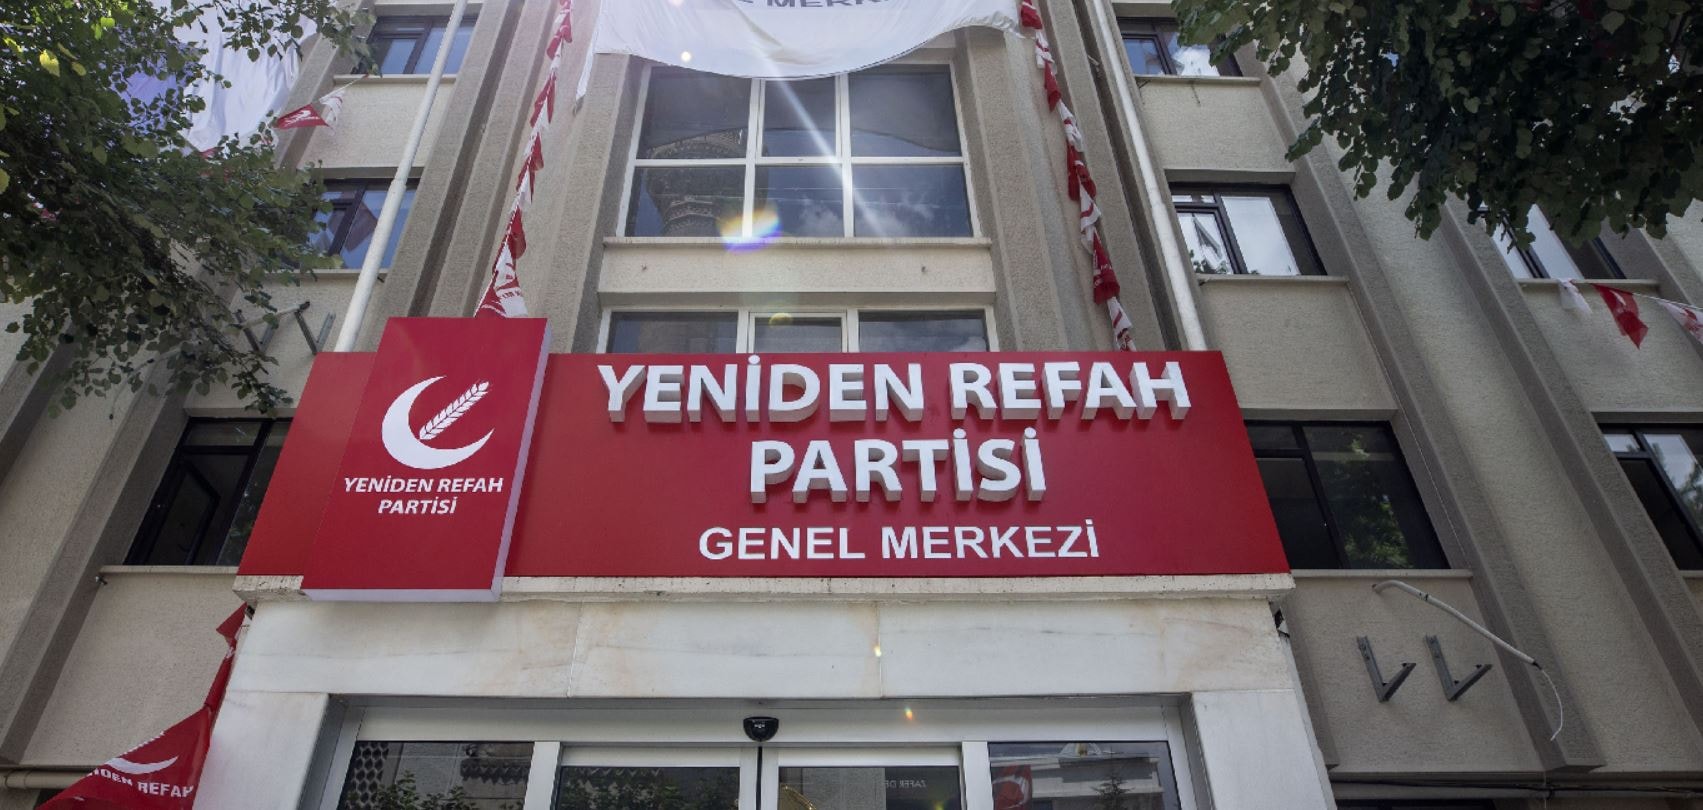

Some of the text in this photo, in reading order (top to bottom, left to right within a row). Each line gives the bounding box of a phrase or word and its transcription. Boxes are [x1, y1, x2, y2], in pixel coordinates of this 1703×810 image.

[598, 354, 1192, 423] YENİDEN REFAH
[344, 475, 504, 493] YENİDEN REFAH
[750, 427, 1046, 503] PARTİSİ
[378, 496, 458, 514] PARTİSİ
[700, 519, 1100, 560] GENEL MERKEZİ
